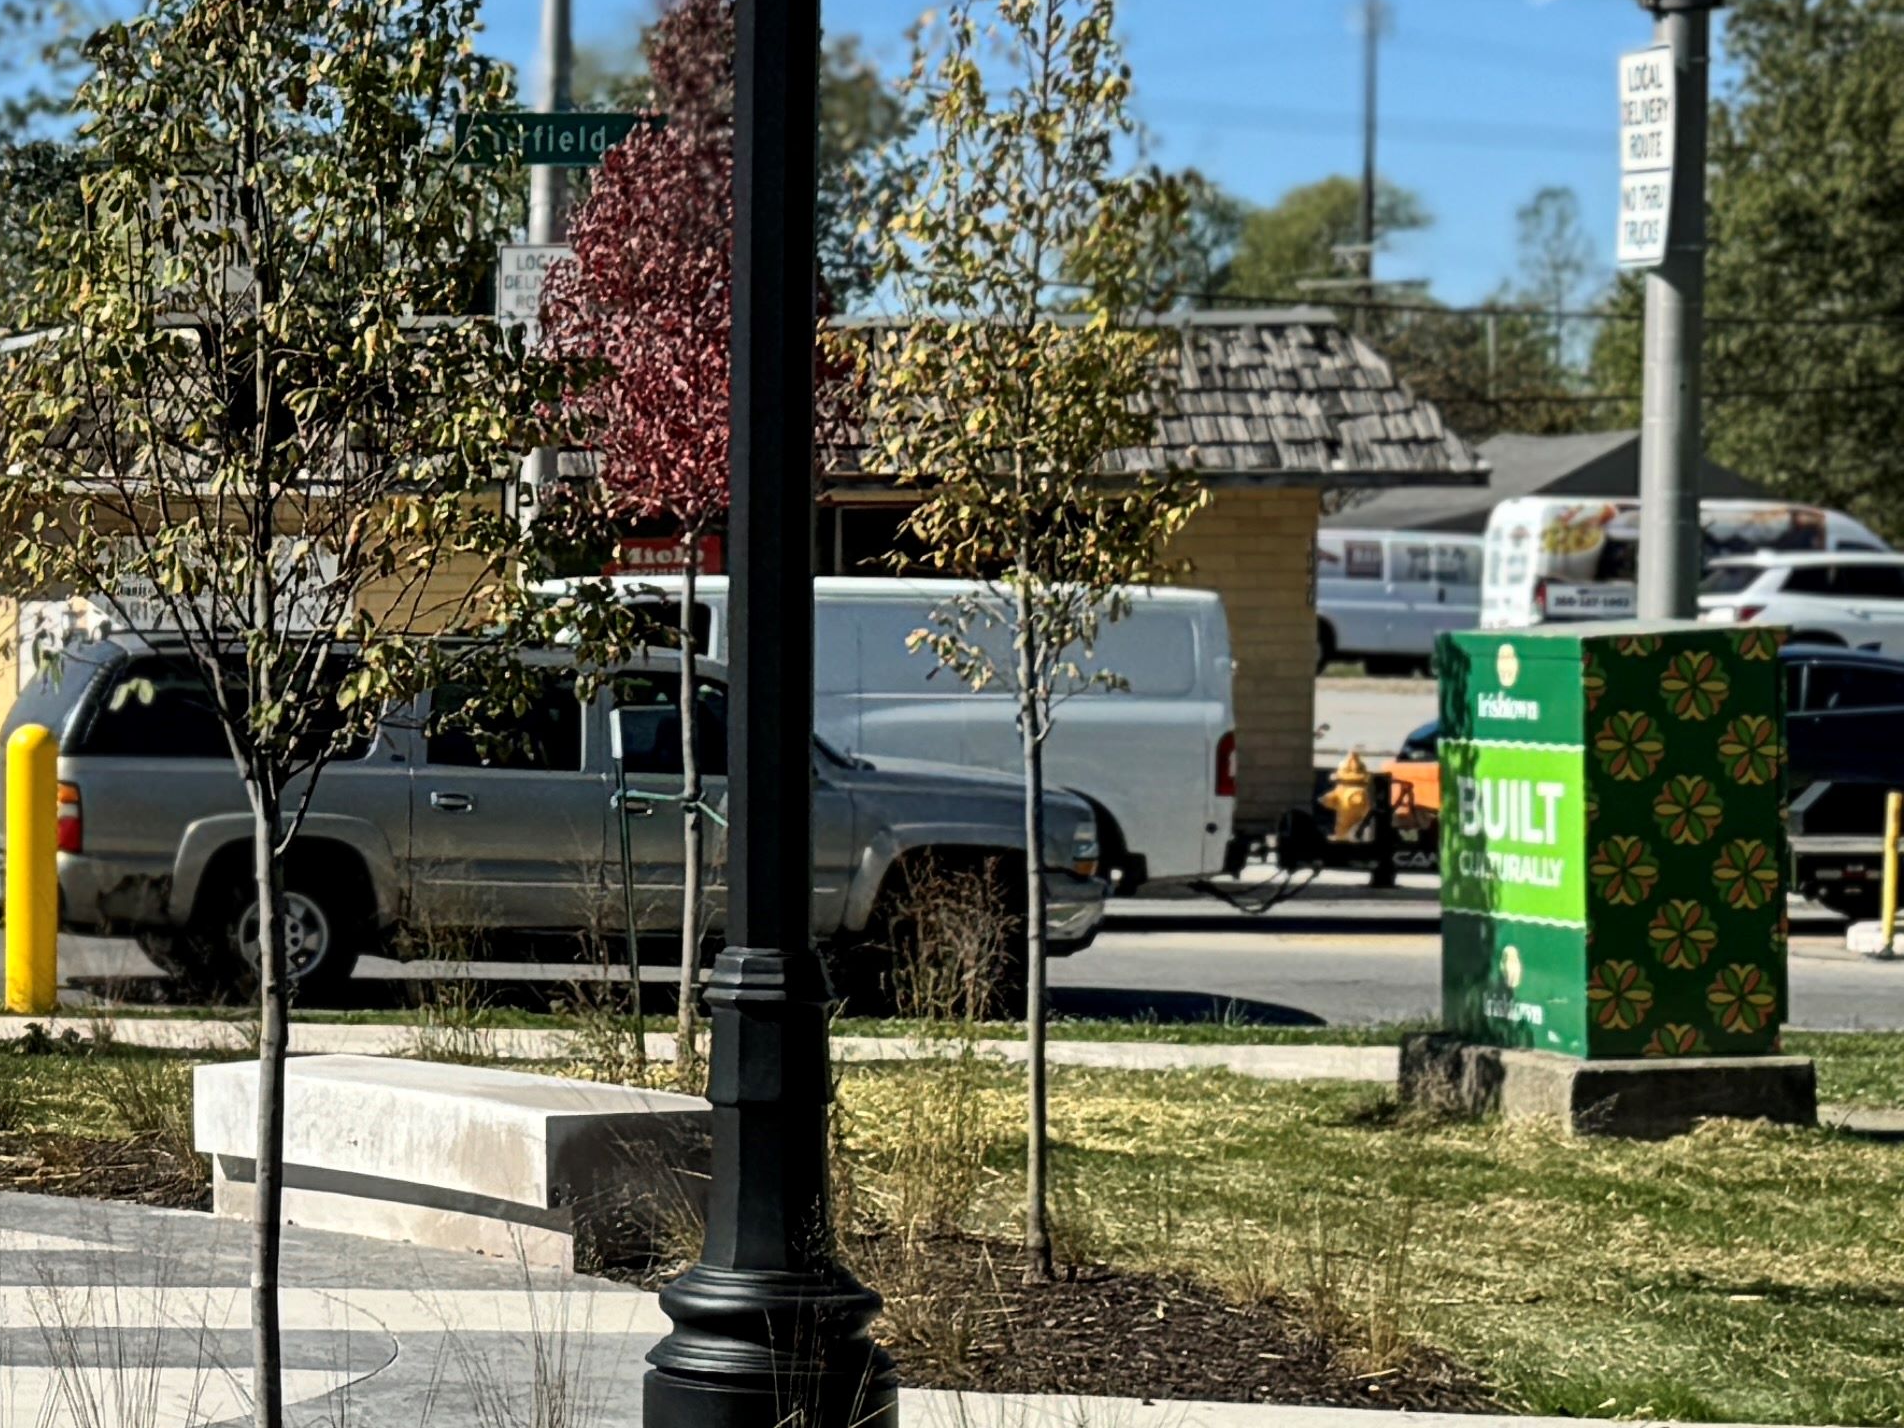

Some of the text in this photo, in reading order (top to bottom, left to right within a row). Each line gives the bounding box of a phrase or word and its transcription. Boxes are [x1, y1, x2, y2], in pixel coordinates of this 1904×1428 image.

[1628, 63, 1664, 92] LOCAL
[1623, 97, 1670, 126] DELIVERY
[1630, 130, 1663, 159] ROUTE
[1478, 691, 1539, 721] Irishtown
[1457, 775, 1565, 845] BUILT
[1458, 849, 1565, 888] CULTURALLY
